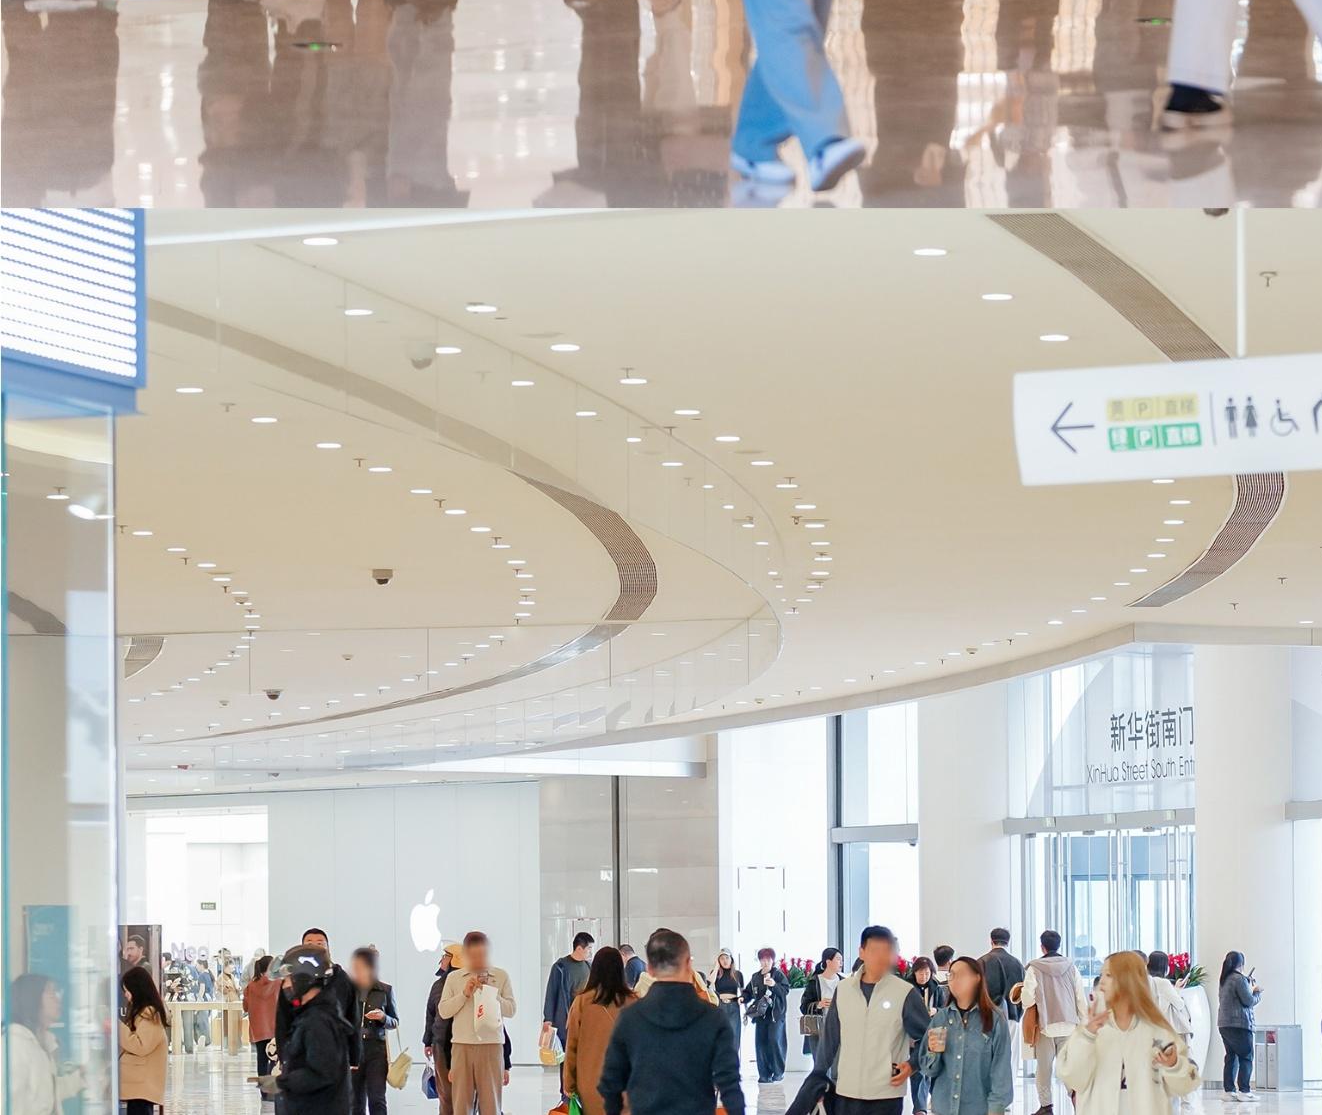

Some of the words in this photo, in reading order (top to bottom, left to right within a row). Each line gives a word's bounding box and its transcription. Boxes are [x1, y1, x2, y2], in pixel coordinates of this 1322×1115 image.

[1110, 706, 1194, 752] 新华街南门
[1086, 763, 1119, 783] XinHua
[1121, 759, 1149, 781] Street
[1151, 755, 1177, 779] South
